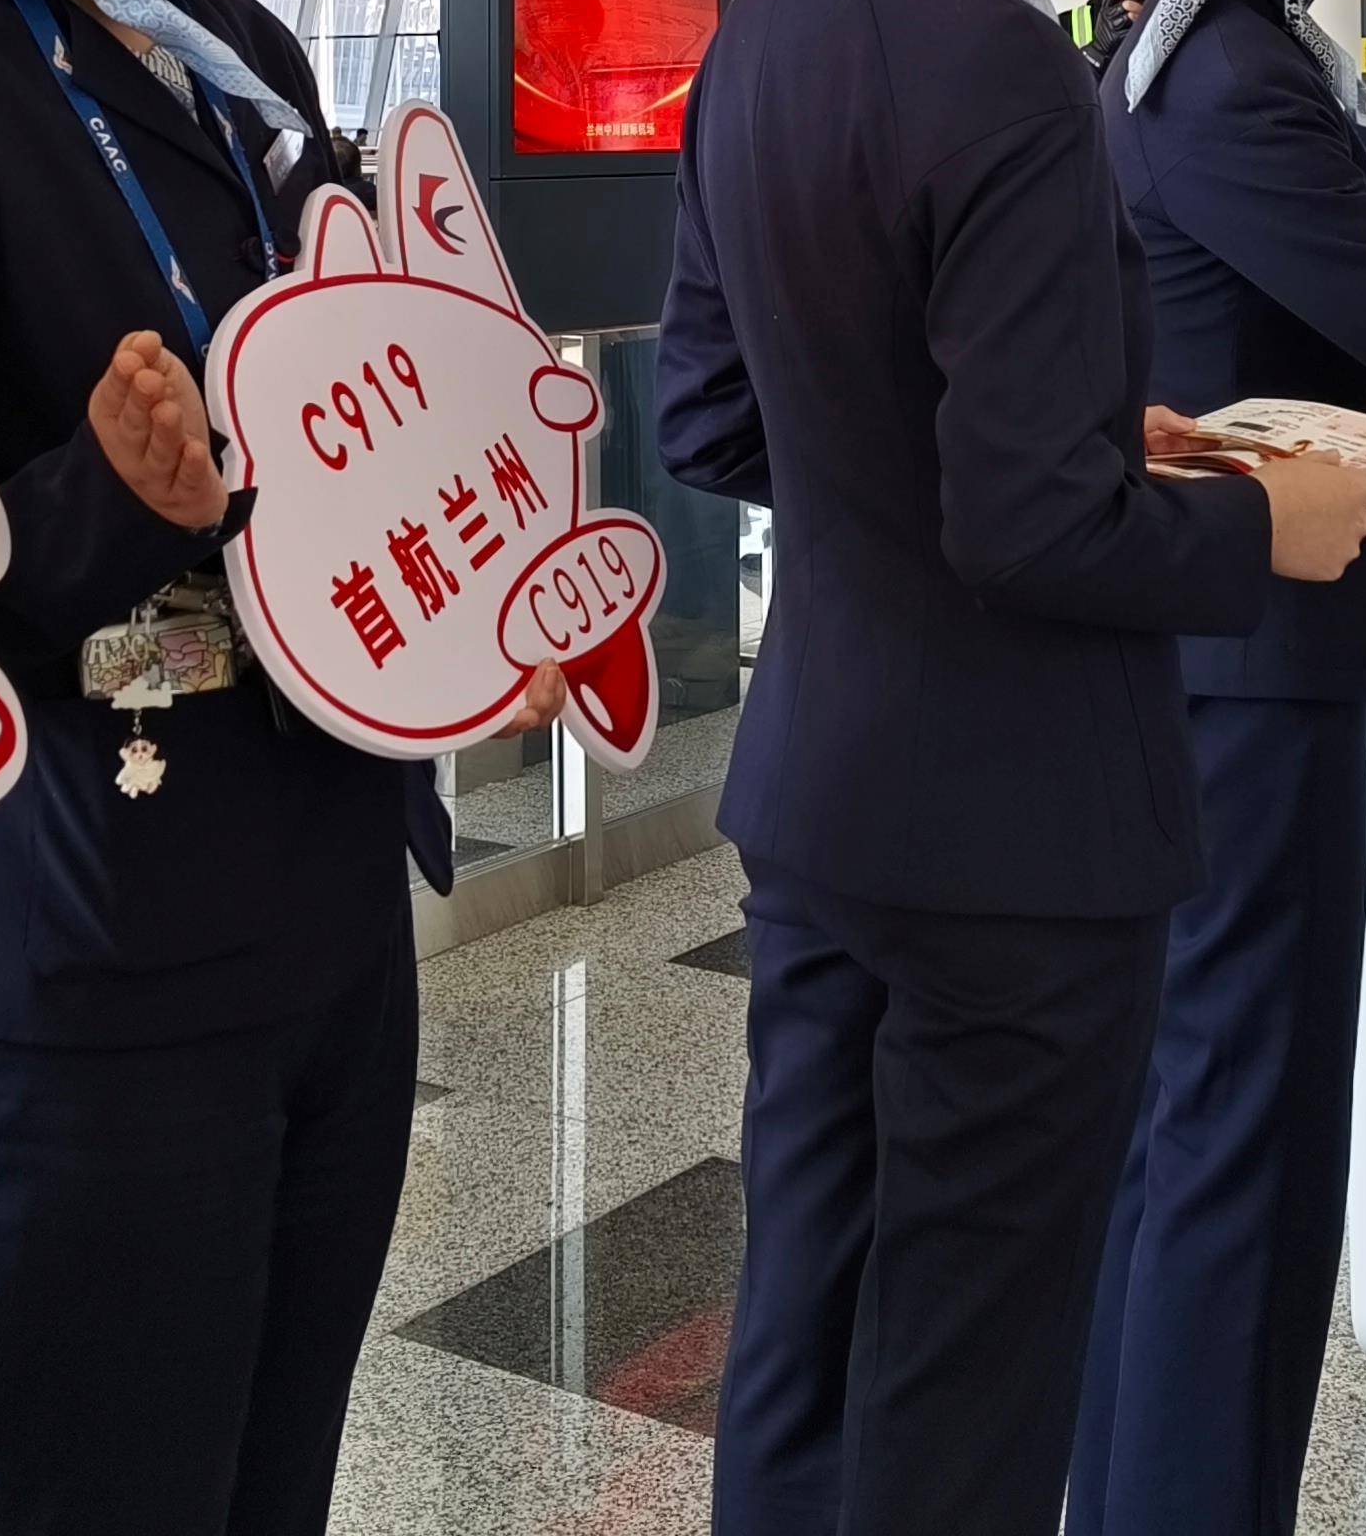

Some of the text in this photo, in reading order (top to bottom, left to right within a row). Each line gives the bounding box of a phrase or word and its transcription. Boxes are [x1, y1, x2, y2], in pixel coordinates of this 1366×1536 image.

[90, 116, 128, 173] CAAC
[301, 343, 428, 471] C919
[330, 433, 549, 671] 首航兰州
[528, 535, 636, 652] C919
